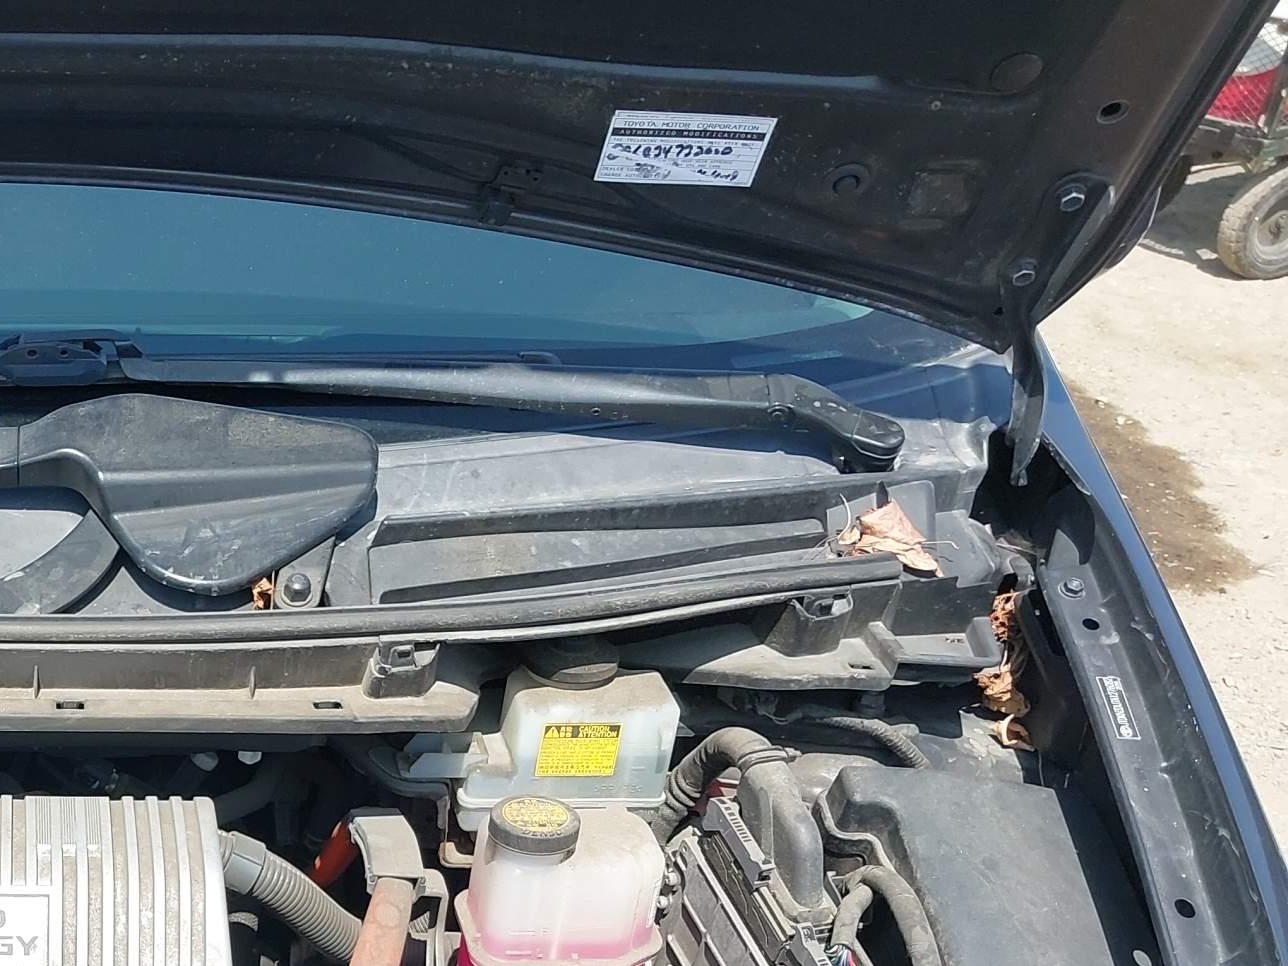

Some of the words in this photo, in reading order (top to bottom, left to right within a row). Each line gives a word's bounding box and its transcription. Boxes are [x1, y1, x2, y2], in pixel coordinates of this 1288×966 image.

[623, 120, 657, 128] TOYOTA
[661, 121, 691, 129] MOTOR
[696, 122, 760, 131] CORPORATION
[683, 131, 758, 139] MODIFICATIONS
